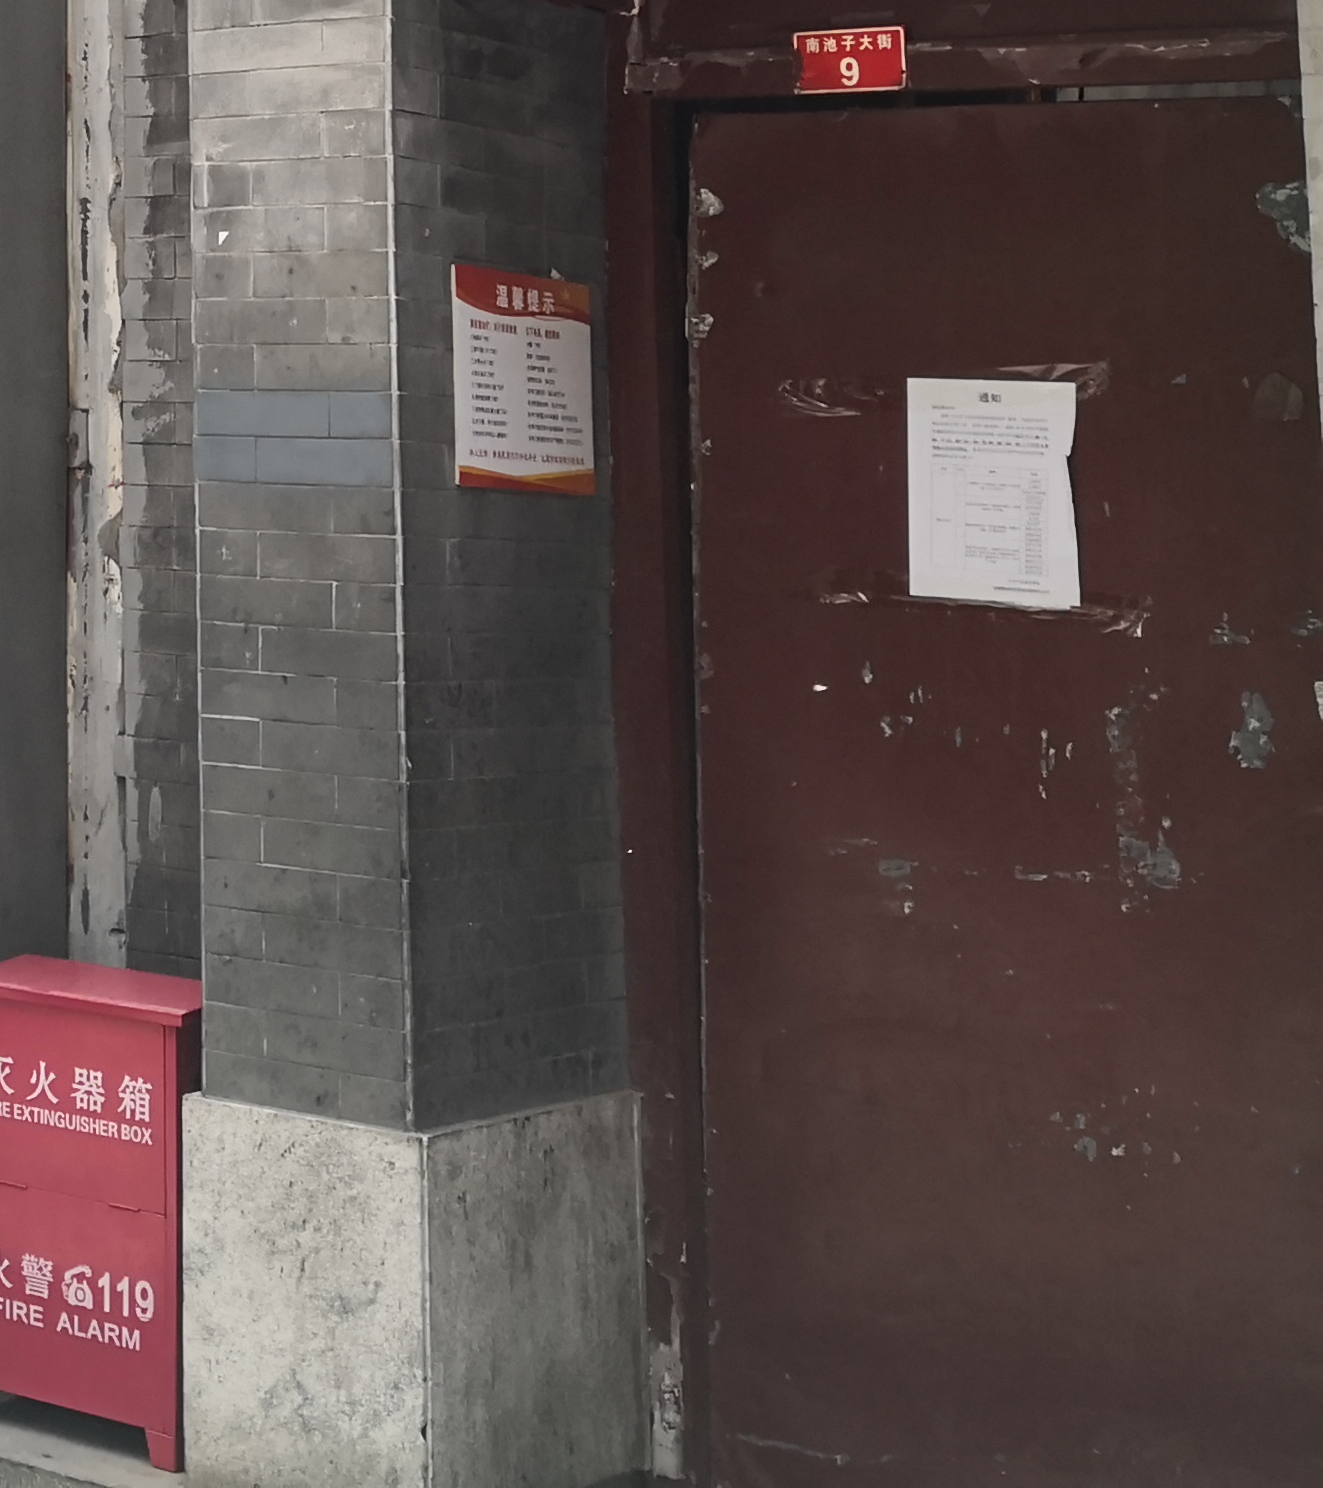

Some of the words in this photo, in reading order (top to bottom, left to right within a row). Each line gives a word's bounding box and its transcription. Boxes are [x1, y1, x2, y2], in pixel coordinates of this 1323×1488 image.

[805, 33, 892, 54] 南池子大街
[839, 56, 860, 87] 9
[495, 284, 555, 315] 温馨提示
[978, 392, 1002, 404] 通知
[13, 1102, 118, 1139] EXTINGUISHER
[121, 1122, 153, 1145] BOX
[97, 1271, 155, 1323] 119
[56, 1311, 141, 1351] ALARM
